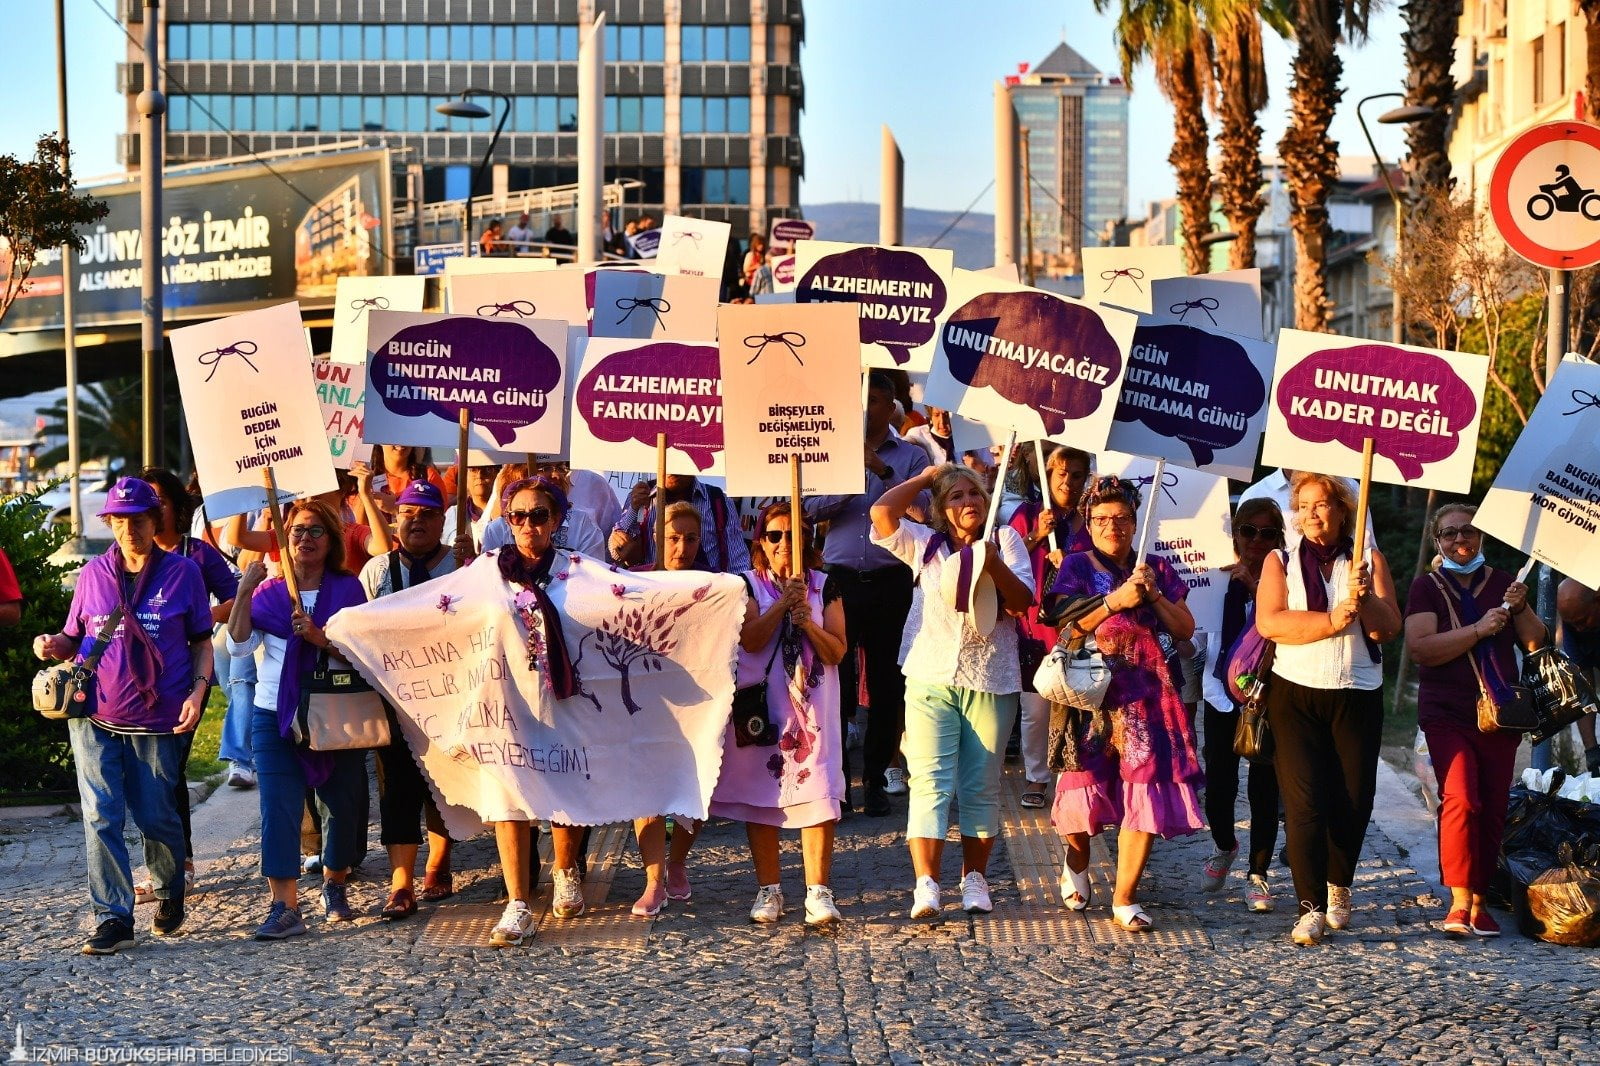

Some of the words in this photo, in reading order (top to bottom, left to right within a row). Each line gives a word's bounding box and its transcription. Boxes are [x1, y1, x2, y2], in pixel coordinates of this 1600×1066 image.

[203, 205, 270, 253] İZMİR
[810, 275, 934, 299] ALZHEIMER'IN
[388, 340, 452, 358] BUGÜN
[947, 325, 1110, 386] UNUTMAYACAĞIZ
[1130, 343, 1170, 366] GÜN
[387, 362, 501, 383] UNUTANLARI
[386, 384, 488, 404] HATIRLAMA
[492, 387, 545, 407] GÜNÜ
[593, 375, 723, 397] ALZHEIMER'I
[1314, 368, 1440, 404] UNUTMAK
[240, 401, 278, 420] BUGÜN
[592, 400, 724, 428] FARKINDAYI
[768, 403, 825, 420] BİRŞEYLER
[1198, 406, 1247, 431] GÜNÜ
[1290, 396, 1375, 426] KADER
[1380, 408, 1454, 437] DEĞİL
[244, 418, 281, 436] DEDEM
[758, 417, 836, 436] DEĞİŞMELİYDİ,
[254, 433, 277, 452] İÇİN
[775, 435, 820, 451] DEĞİŞEN
[235, 445, 303, 474] YÜRÜYORUM
[768, 453, 789, 464] BEN
[791, 452, 830, 464] LDUM
[1545, 470, 1585, 497] BABAM
[1538, 482, 1586, 512] (KAHRAMANIM
[1529, 493, 1557, 513] MOR
[1557, 508, 1598, 535] GİYDİM
[1154, 537, 1193, 551] BUGÜN
[1183, 550, 1206, 565] İÇİN
[381, 641, 464, 672] AKLINA
[396, 672, 460, 702] GELİR
